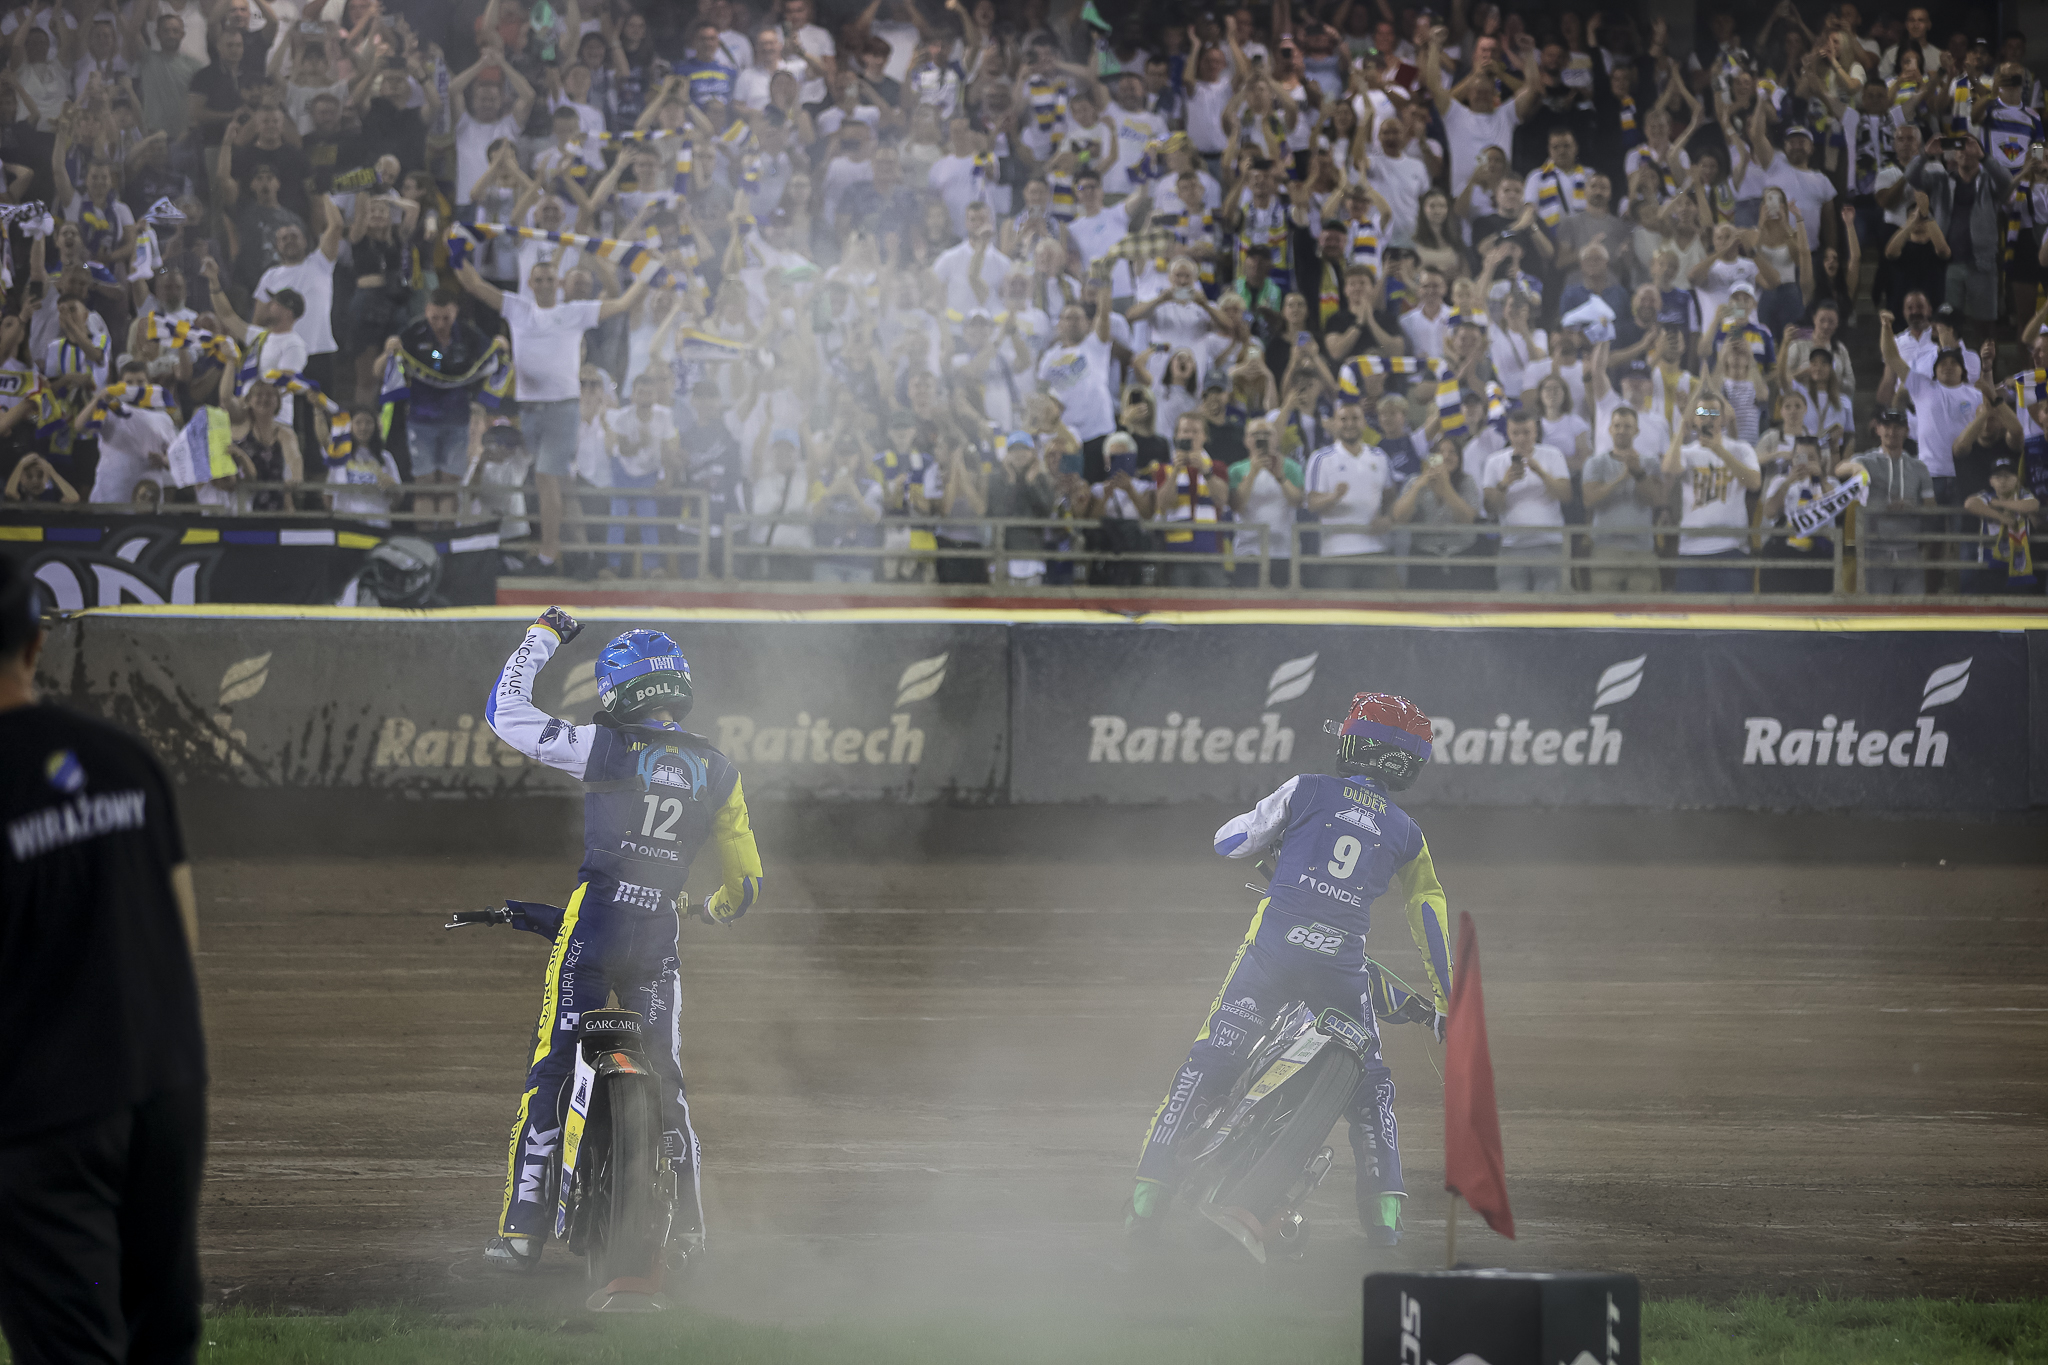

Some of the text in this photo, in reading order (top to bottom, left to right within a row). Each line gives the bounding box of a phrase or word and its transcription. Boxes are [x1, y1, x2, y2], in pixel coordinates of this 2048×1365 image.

[508, 634, 537, 695] NICOLAUS
[376, 712, 530, 768] Raite
[716, 712, 926, 765] Raitech
[1087, 711, 1296, 765] Raitech
[1431, 714, 1623, 766] Raitech
[1742, 714, 1949, 768] Raitech
[640, 794, 684, 841] 12
[1343, 786, 1388, 816] DUDEK
[638, 845, 679, 861] ONDE
[1327, 834, 1362, 880] 9
[1317, 881, 1362, 908] ONDE
[1286, 926, 1344, 955] 692
[585, 1019, 642, 1033] GARCAREK
[518, 1123, 561, 1204] MK
[1400, 1290, 1422, 1365] SC
